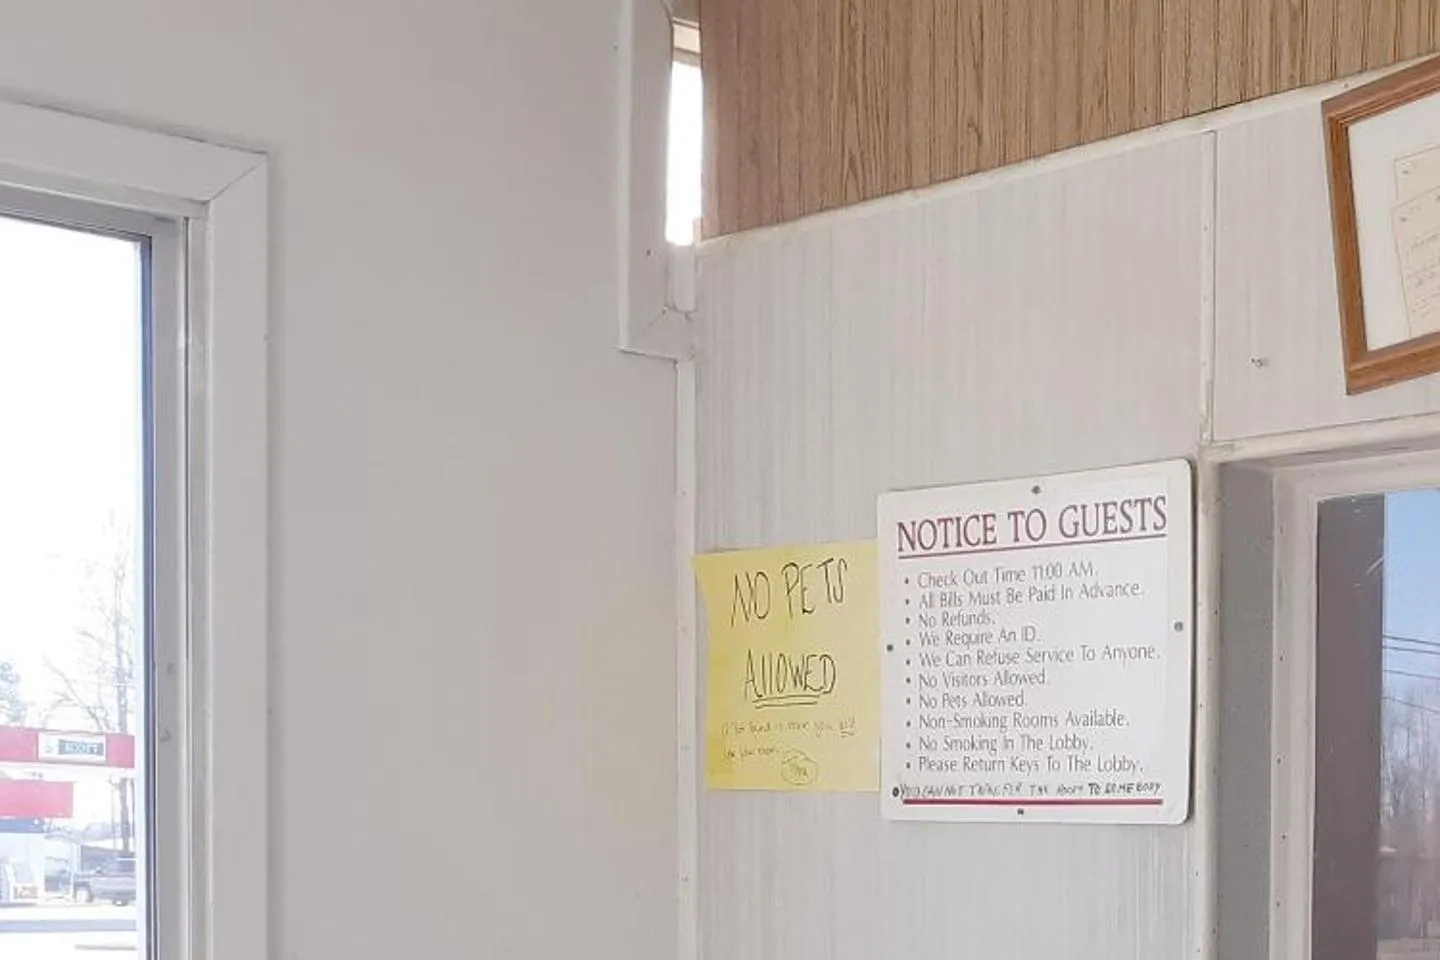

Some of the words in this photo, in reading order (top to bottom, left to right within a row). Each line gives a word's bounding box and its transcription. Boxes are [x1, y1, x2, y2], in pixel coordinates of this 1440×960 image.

[897, 513, 997, 551] NOTICE
[1007, 508, 1047, 543] TO
[1058, 496, 1167, 539] GUESTS
[917, 570, 959, 589] Check
[963, 568, 988, 586] Out
[994, 565, 1026, 584] Time
[730, 571, 771, 627] NO
[781, 558, 848, 620] PETS
[919, 591, 935, 609] All
[939, 590, 963, 608] Bills
[968, 590, 1001, 606] Must
[1006, 586, 1023, 604] Be
[1028, 584, 1055, 602] Paid
[1061, 583, 1074, 600] In
[919, 613, 937, 628] No
[919, 630, 940, 647] We
[945, 628, 994, 650] Require
[998, 627, 1017, 643] An
[919, 651, 941, 668] We
[945, 650, 971, 667] Can
[976, 648, 1020, 665] Refuse
[1024, 646, 1074, 664] Service
[1081, 644, 1096, 661] To
[919, 672, 938, 689] No
[942, 671, 988, 689] Visitors
[919, 693, 938, 710] No
[942, 692, 968, 709] Pets
[919, 712, 1007, 734] Non-Smoking
[1013, 711, 1058, 728] Rooms
[919, 735, 938, 751] No
[943, 734, 998, 757] Smoking
[1020, 734, 1043, 751] The
[918, 756, 957, 773] Please
[963, 756, 1005, 773] Return
[1010, 755, 1040, 776] Keys
[1047, 755, 1061, 773] To
[1068, 755, 1091, 773] The
